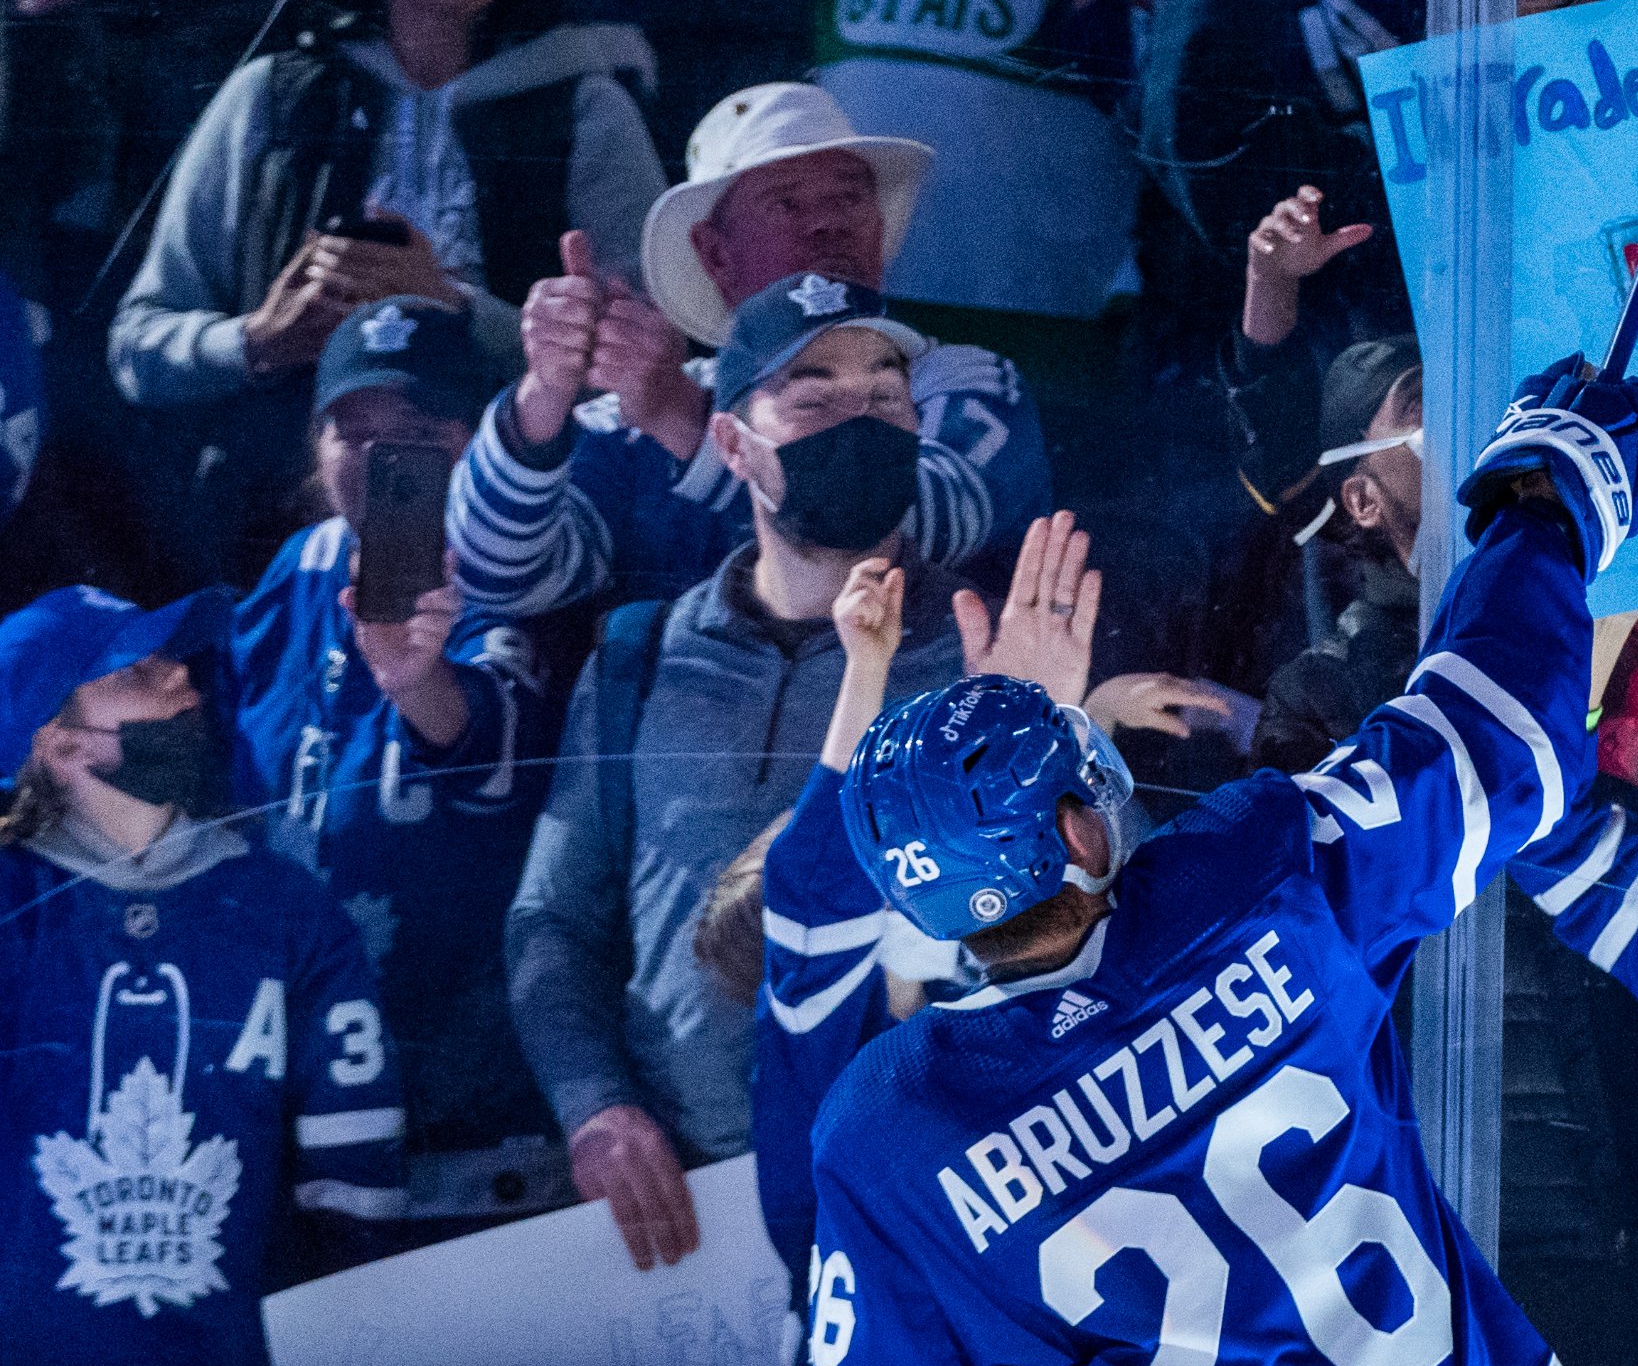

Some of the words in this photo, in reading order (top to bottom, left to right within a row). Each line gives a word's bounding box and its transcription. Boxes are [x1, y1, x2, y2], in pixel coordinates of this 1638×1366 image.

[884, 840, 941, 888] 26
[224, 978, 288, 1079] A
[1051, 999, 1110, 1040] adidas
[326, 999, 385, 1087] 3
[938, 931, 1315, 1253] ABRUZZESE
[76, 1175, 214, 1216] TORONTO
[97, 1212, 193, 1236] MAPLE
[97, 1241, 193, 1265] LEAFS
